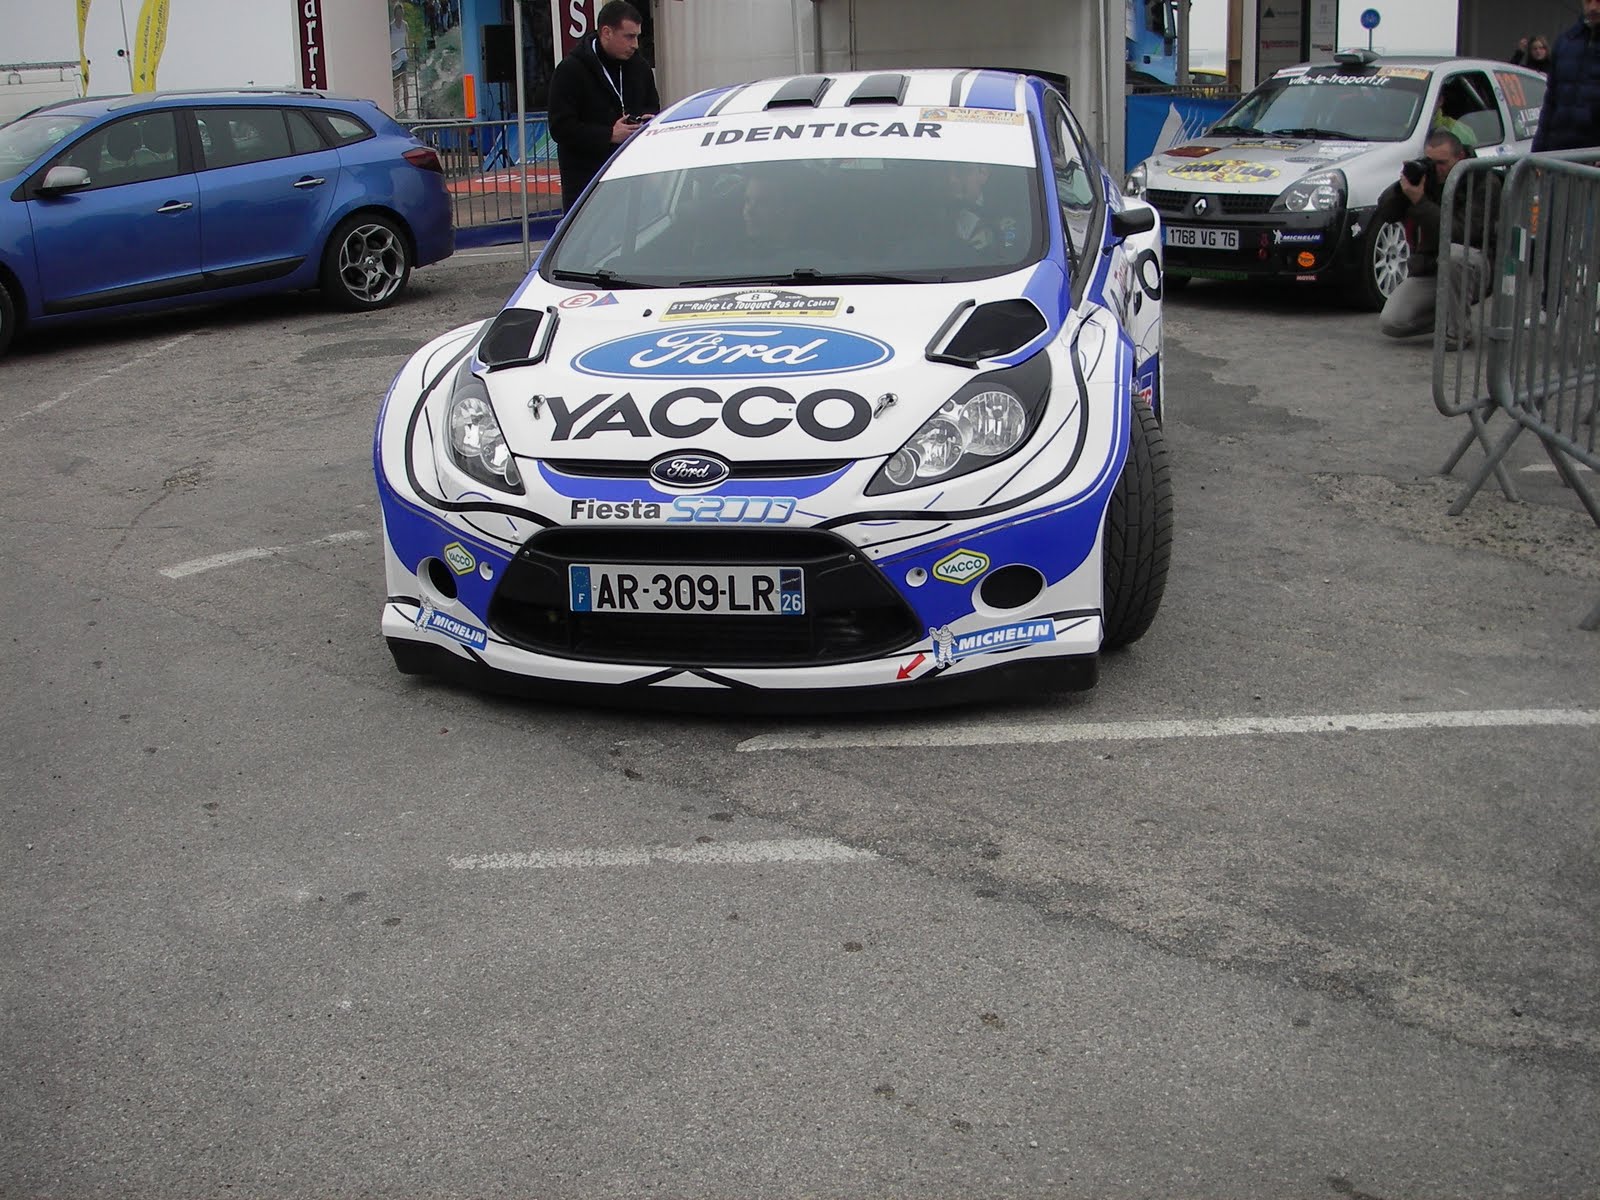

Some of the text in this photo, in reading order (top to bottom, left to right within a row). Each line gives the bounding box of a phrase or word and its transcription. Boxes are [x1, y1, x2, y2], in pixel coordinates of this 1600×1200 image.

[700, 122, 942, 147] IDENTICAR
[1170, 229, 1236, 247] 1768 VG 76
[691, 301, 719, 312] Rallye
[721, 301, 733, 310] Le
[735, 300, 772, 311] Touquet
[773, 300, 792, 309] Pas
[793, 300, 804, 308] de
[807, 299, 836, 307] Calais
[629, 328, 828, 369] Ford
[545, 386, 872, 442] YACCO
[666, 459, 711, 479] Ford
[570, 499, 661, 520] Fiesta
[449, 551, 471, 567] YACCO
[943, 558, 982, 575] YACCO
[578, 593, 586, 604] F
[597, 573, 775, 612] AR-309-LR
[782, 593, 801, 612] 26
[433, 615, 485, 643] MICHELIN
[959, 624, 1050, 651] MICHELIN
